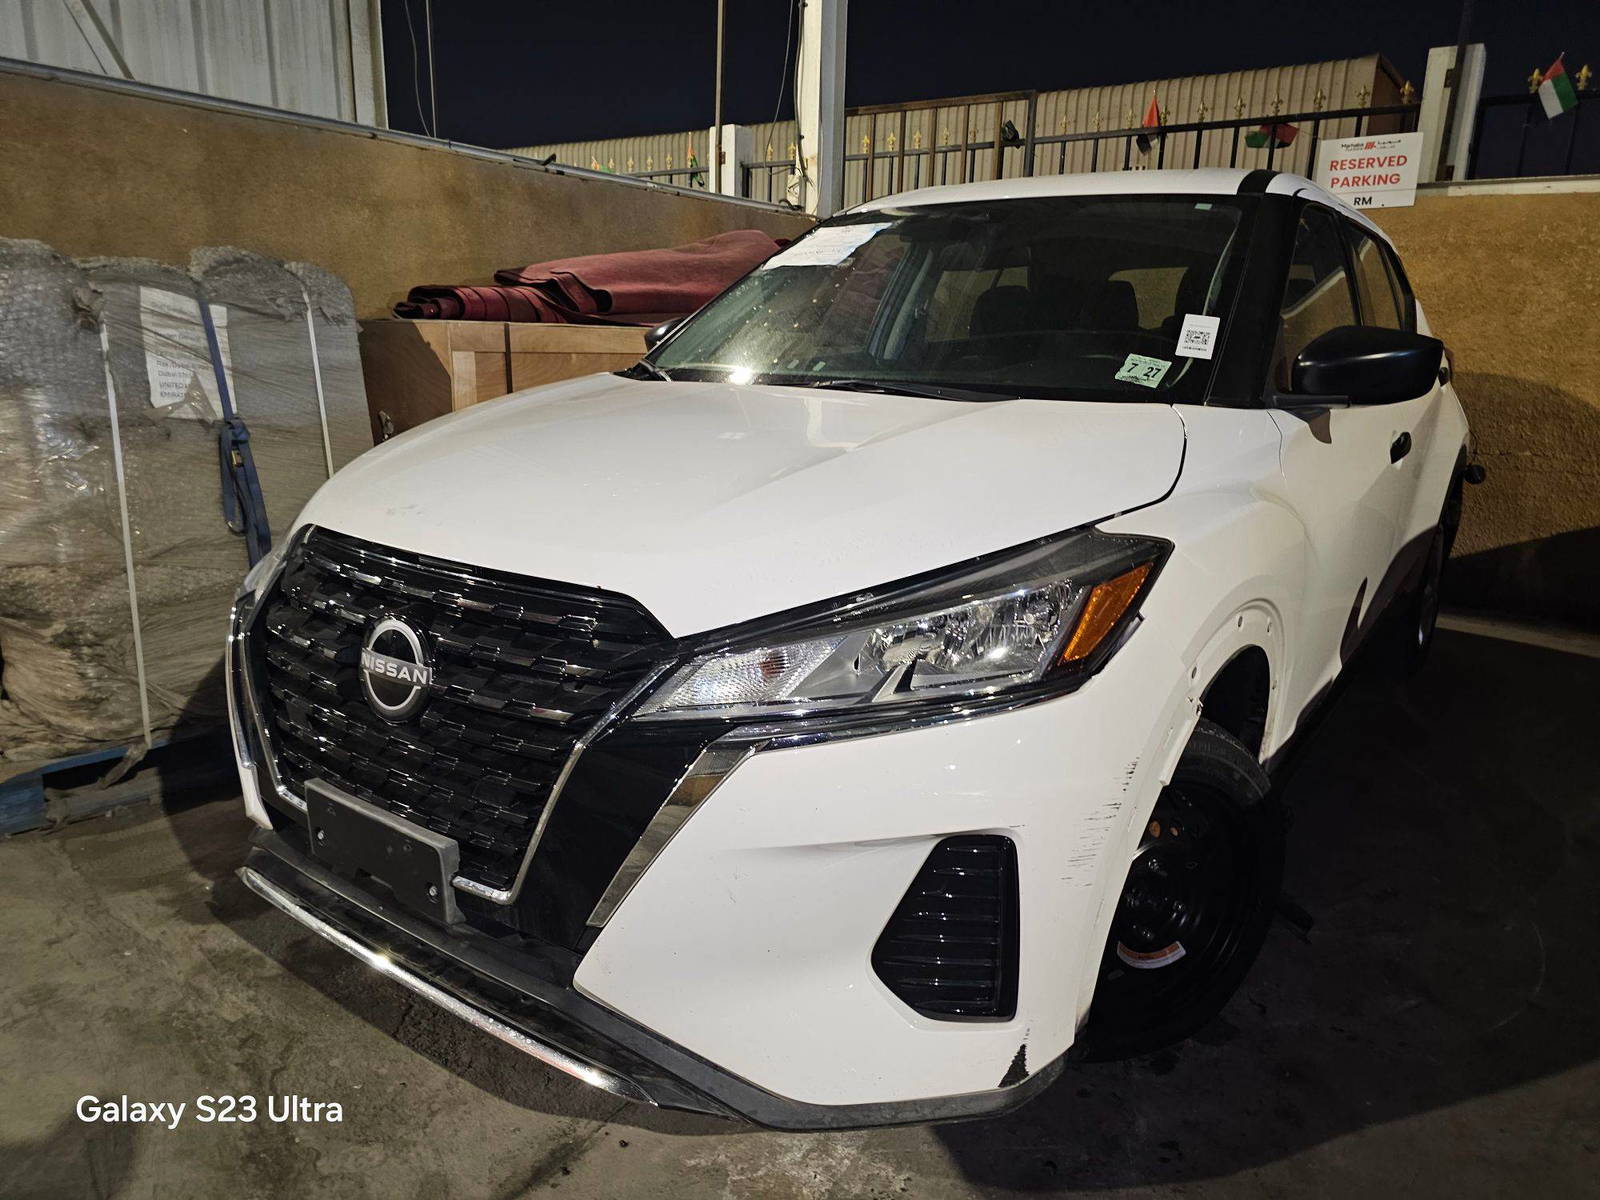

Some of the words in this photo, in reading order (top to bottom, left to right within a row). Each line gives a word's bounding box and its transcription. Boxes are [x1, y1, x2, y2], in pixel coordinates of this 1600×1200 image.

[1329, 155, 1408, 171] RESERVED
[1330, 173, 1401, 189] PARKING
[1353, 196, 1373, 206] RM
[1127, 362, 1139, 374] 7
[1143, 366, 1162, 379] 27
[361, 651, 428, 685] NISSAN
